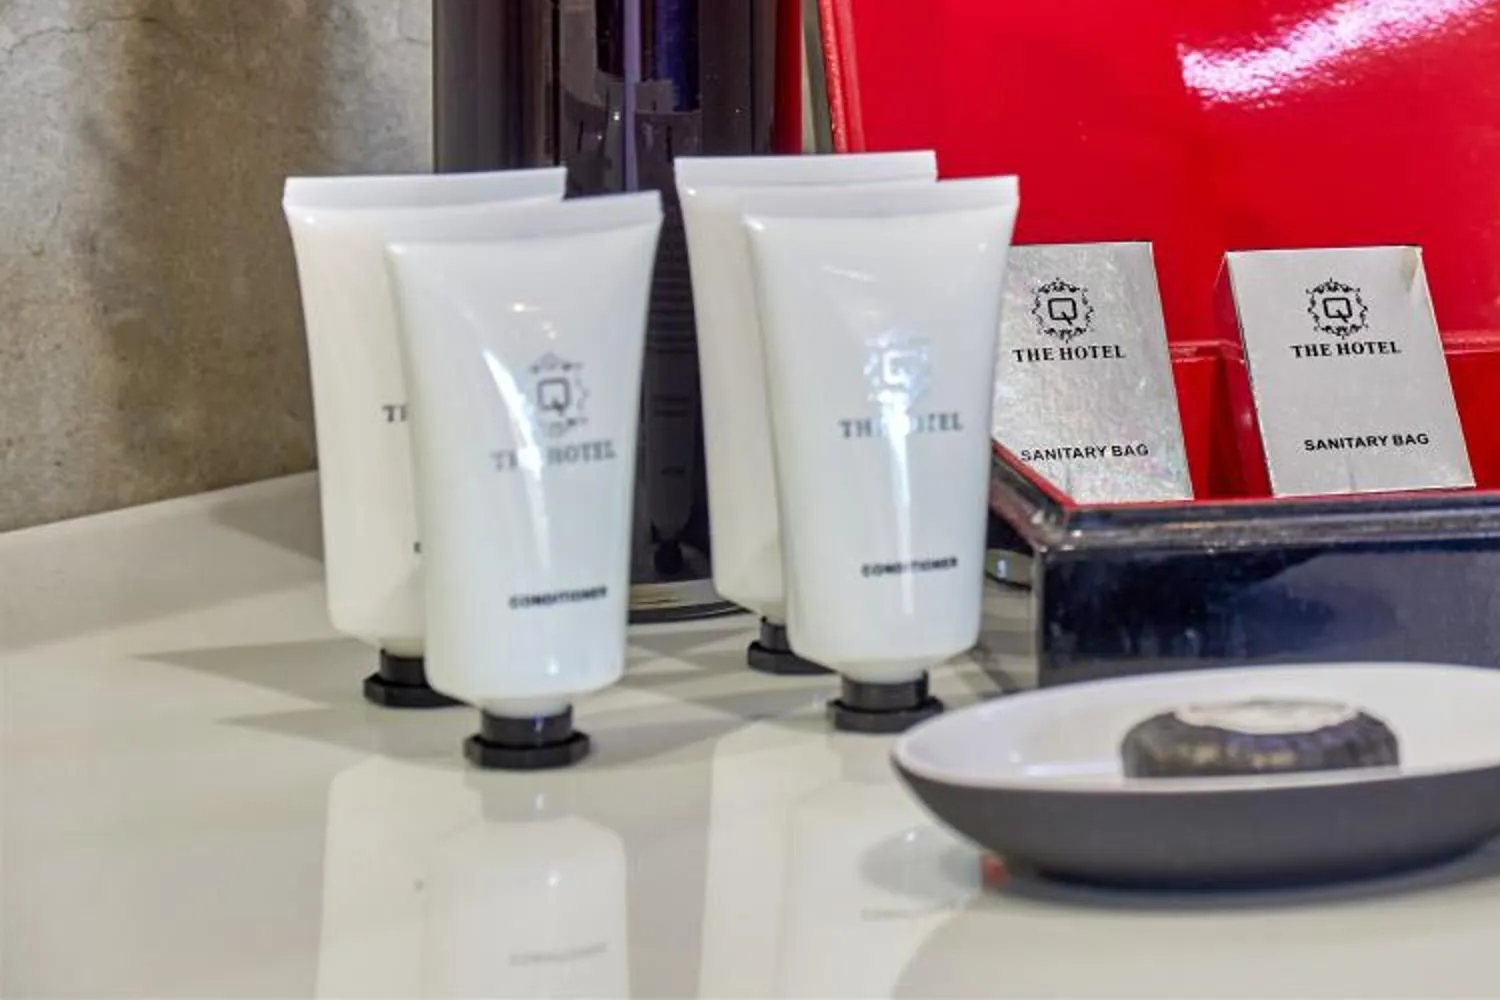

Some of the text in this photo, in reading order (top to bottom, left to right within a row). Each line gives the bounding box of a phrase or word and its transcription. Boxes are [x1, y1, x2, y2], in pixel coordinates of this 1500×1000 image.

[1012, 344, 1127, 362] THE HOTEL
[1289, 341, 1402, 358] THE HOTEL
[838, 417, 886, 438] TH
[1303, 433, 1429, 451] SANITARY BAG
[1020, 443, 1149, 461] SANITARY BAG
